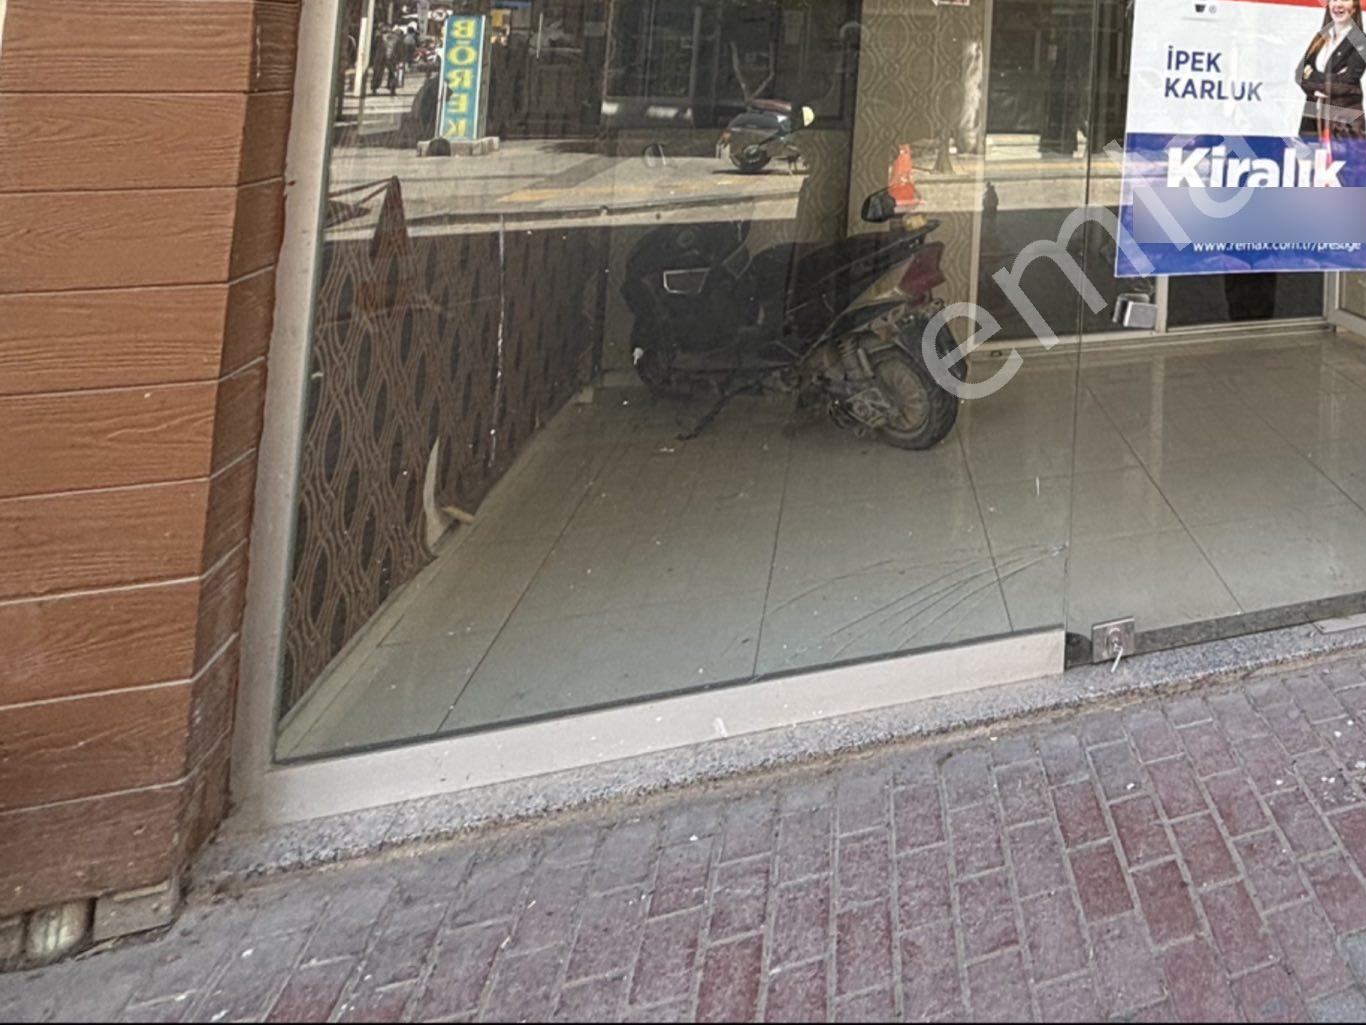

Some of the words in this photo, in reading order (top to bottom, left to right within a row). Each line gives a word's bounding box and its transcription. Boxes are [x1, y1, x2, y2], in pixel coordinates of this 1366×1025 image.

[1167, 45, 1222, 73] İPEK
[1164, 77, 1263, 101] KARLUK
[1167, 145, 1347, 188] Kiralık
